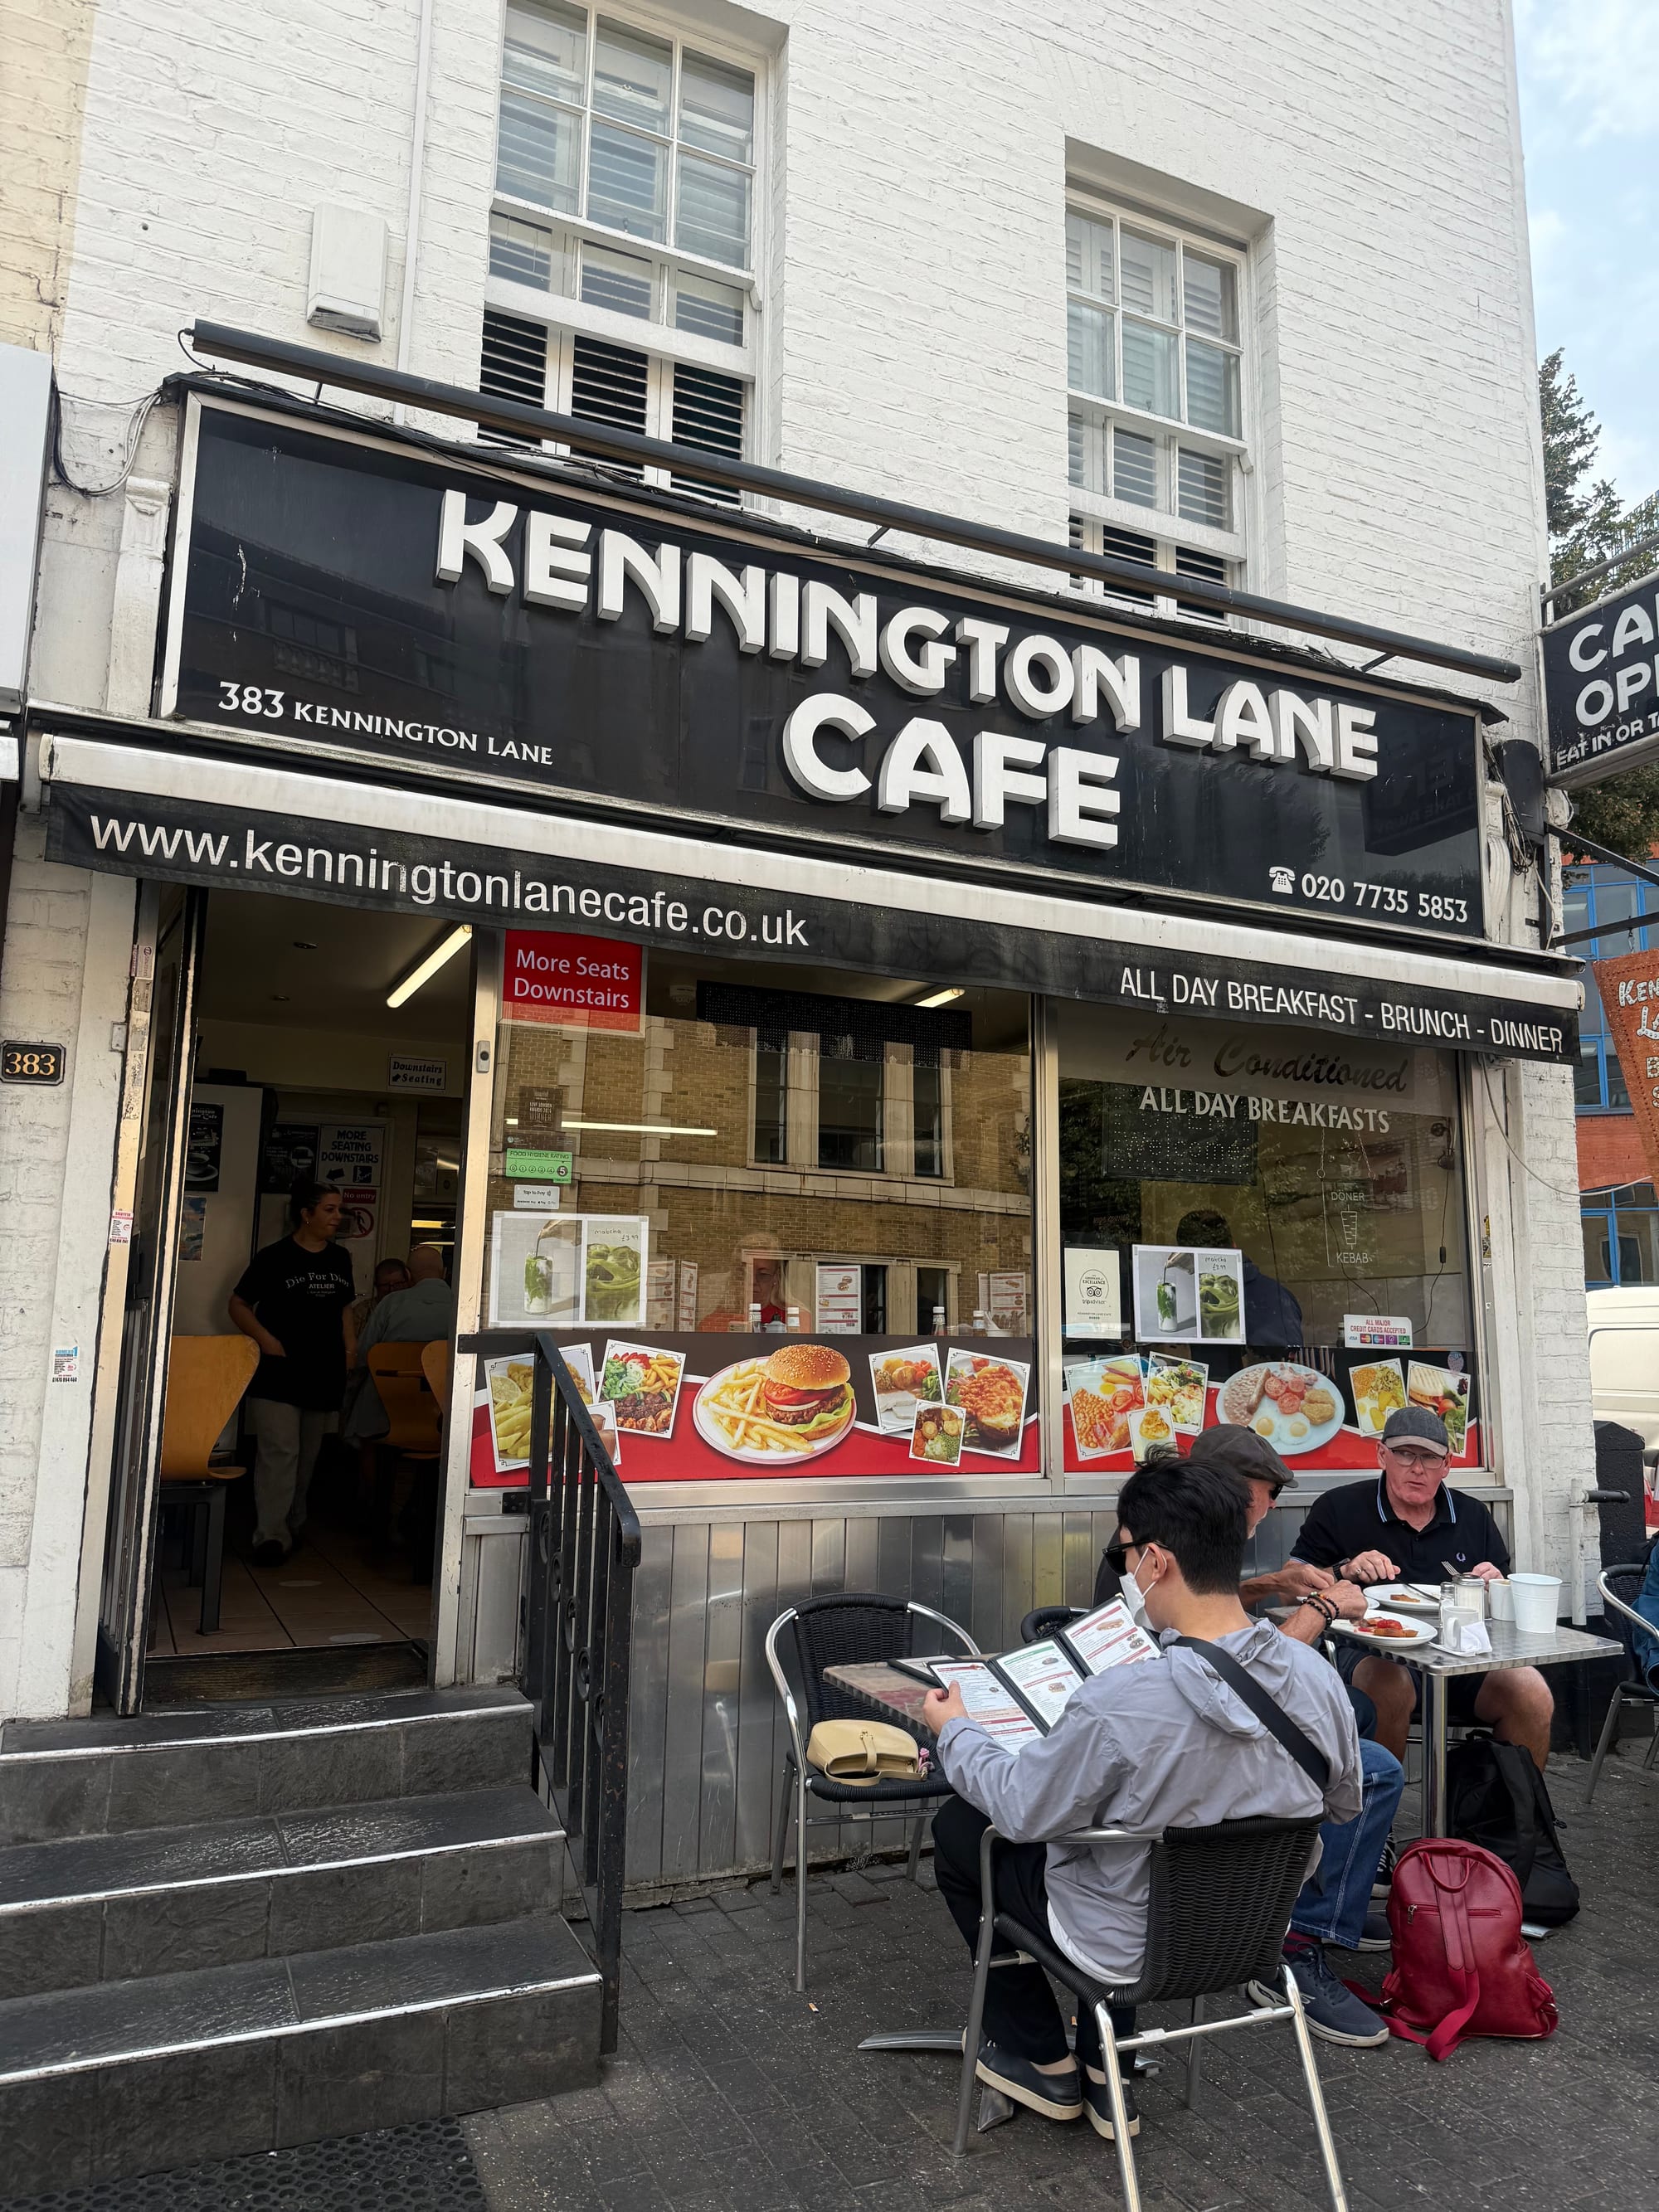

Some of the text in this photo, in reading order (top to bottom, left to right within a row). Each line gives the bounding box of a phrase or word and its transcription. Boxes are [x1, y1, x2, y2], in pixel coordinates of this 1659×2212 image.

[435, 489, 1378, 781] KENNINGTON LANE
[1569, 593, 1659, 673] CA
[1576, 654, 1659, 726] OP
[218, 681, 554, 766] 383 KENNINGTON LANE
[1557, 741, 1588, 766] EAT
[1592, 732, 1611, 752] IN
[1616, 719, 1644, 741] OR
[783, 693, 1120, 850] CAFE
[90, 814, 810, 947] www.kenningtonlanecafe.co.uk
[1301, 873, 1468, 923] 020 7735 5853
[515, 949, 630, 981] More Seats
[513, 978, 630, 1009] Downstairs
[1120, 967, 1164, 1000] ALL
[1173, 975, 1219, 1006] DAY
[1228, 981, 1358, 1025] BREAKFAST
[1382, 1004, 1471, 1040] BRUNCH
[1492, 1018, 1563, 1054] DINNER
[5, 1053, 56, 1076] 383
[392, 1061, 443, 1074] Downstairs
[1126, 1023, 1409, 1093] Air Conditioned
[401, 1073, 442, 1087] Seating
[1139, 1086, 1390, 1134] ALL DAY BREAKFASTS
[331, 1140, 372, 1152] SEATING
[337, 1130, 367, 1140] MORE
[321, 1151, 379, 1164] DOWNSTAIRS
[559, 1167, 566, 1175] 5
[356, 1193, 376, 1201] entry
[1331, 1189, 1365, 1201] DÖNER
[1336, 1252, 1369, 1264] KEBAB
[285, 1276, 306, 1289] Die
[308, 1271, 327, 1281] For
